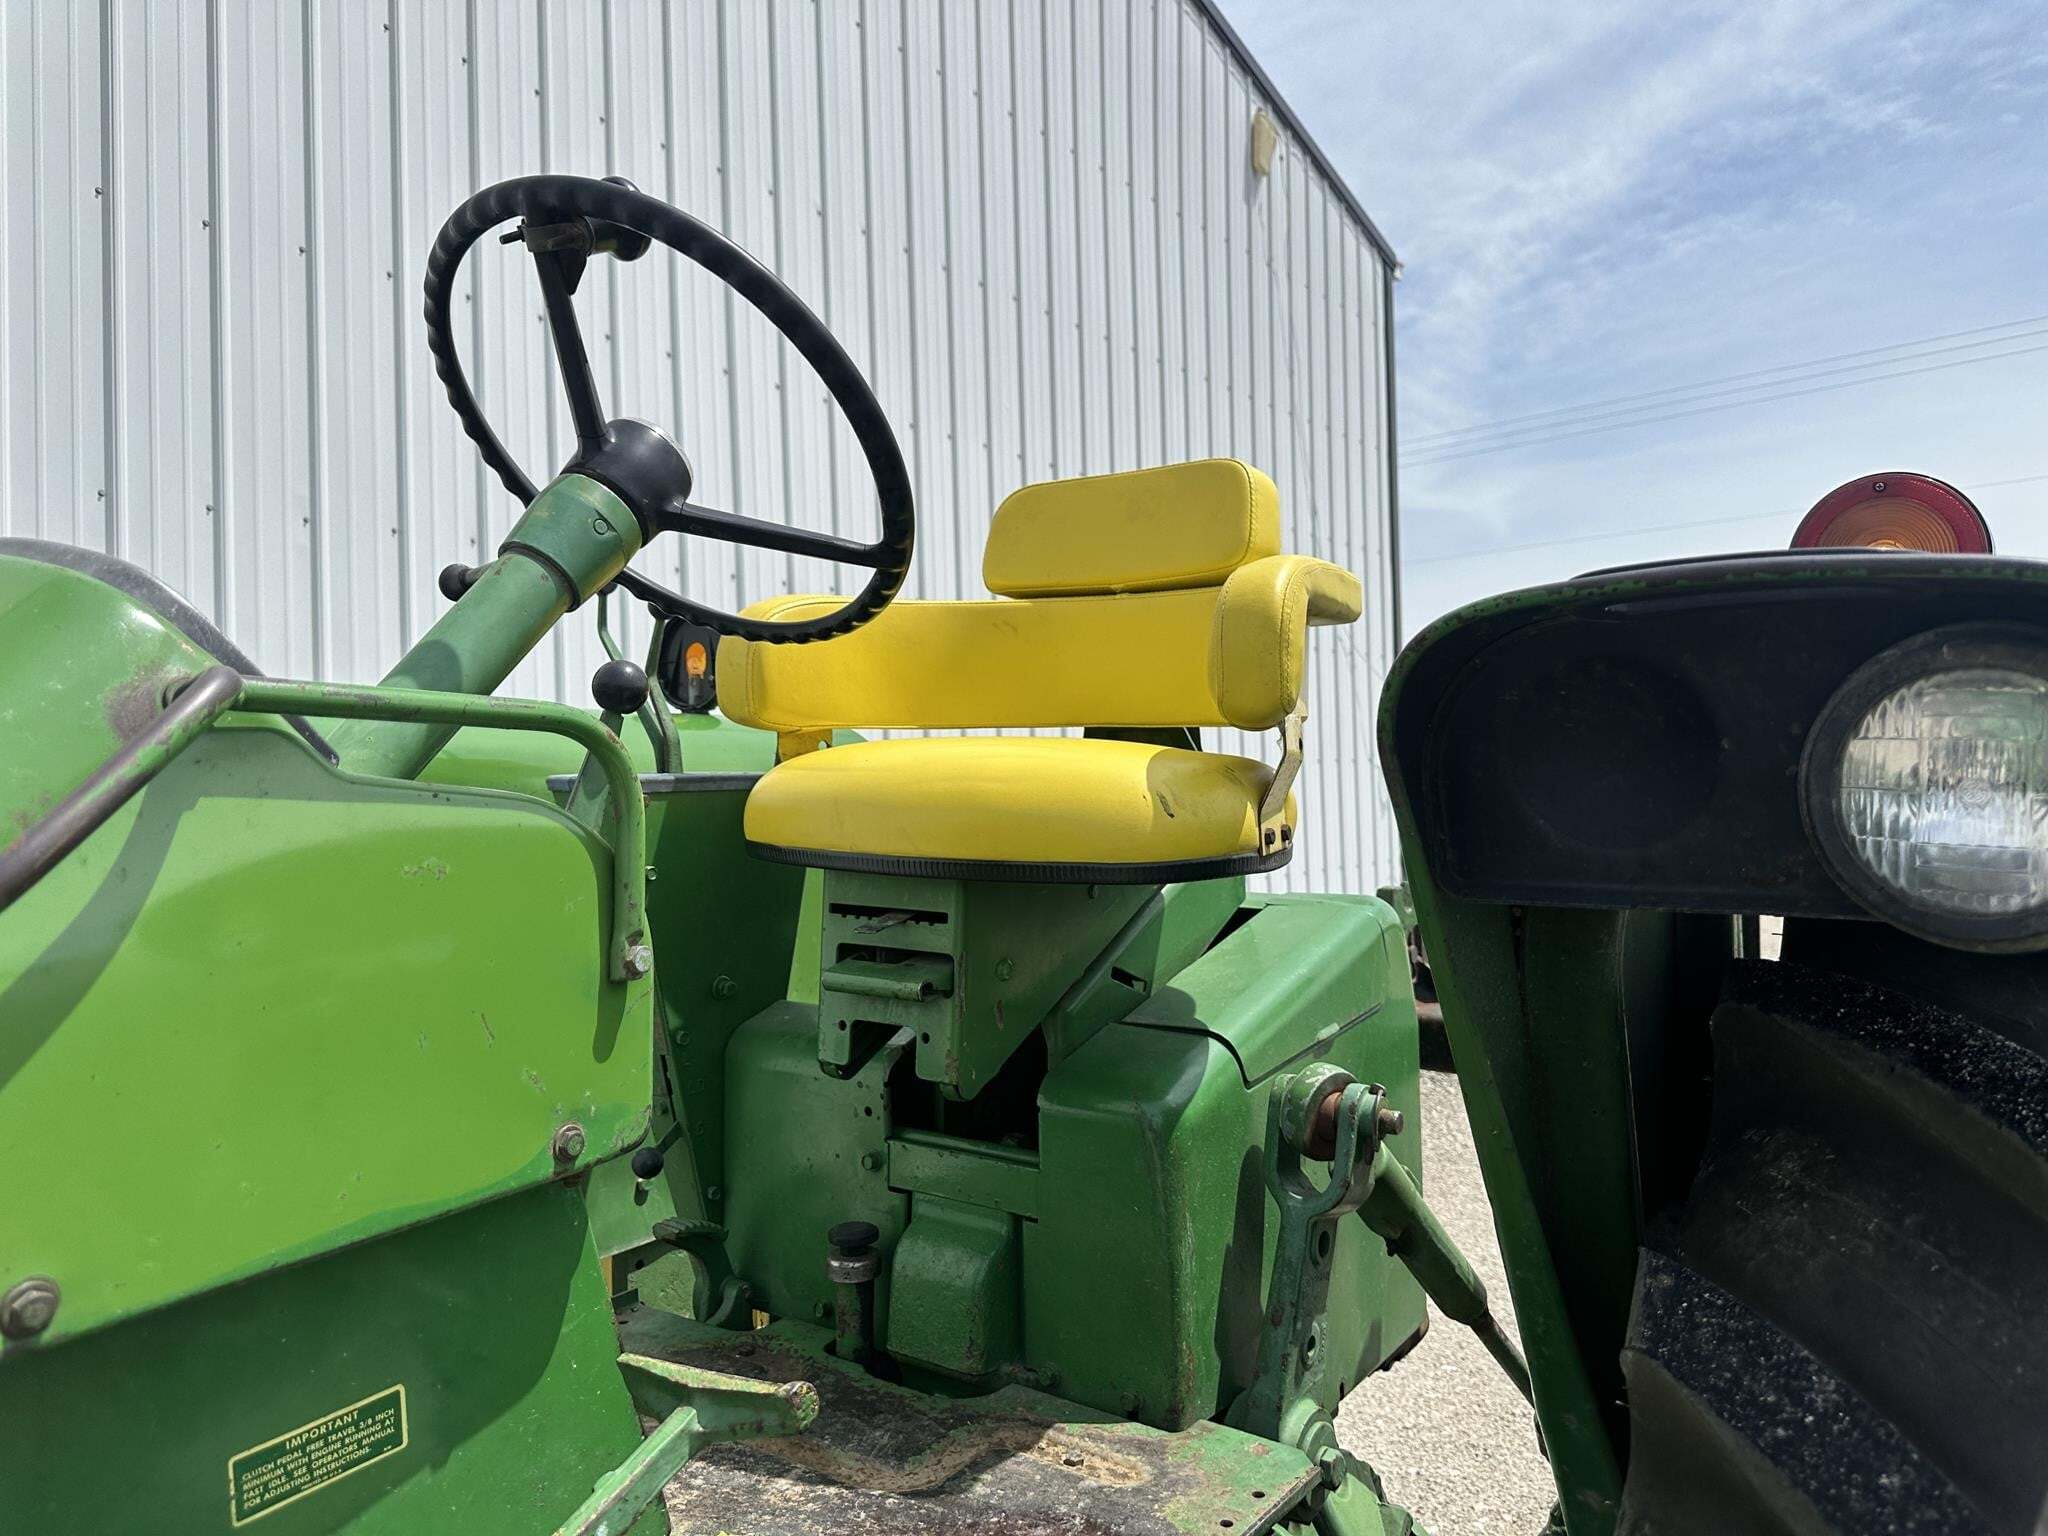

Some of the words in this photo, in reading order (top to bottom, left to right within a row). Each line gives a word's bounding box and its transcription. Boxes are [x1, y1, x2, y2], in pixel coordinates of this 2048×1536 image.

[243, 1463, 274, 1480] CLUTCH
[278, 1450, 302, 1465] PEDAL
[306, 1438, 325, 1453] FREE
[328, 1425, 356, 1442] TRAVEL
[375, 1408, 394, 1422] INCH
[243, 1467, 285, 1491] MINIMUM
[287, 1456, 309, 1470] WITH
[311, 1440, 342, 1460] ENGINE
[344, 1423, 382, 1444] RUNNING
[384, 1416, 395, 1426] AT
[244, 1486, 264, 1500] FAST
[293, 1466, 308, 1478] SEE
[362, 1426, 395, 1446] MANUAL
[286, 1410, 359, 1450] IMPORTANT
[244, 1496, 261, 1510] FOR
[263, 1474, 311, 1501] ADJUSTING
